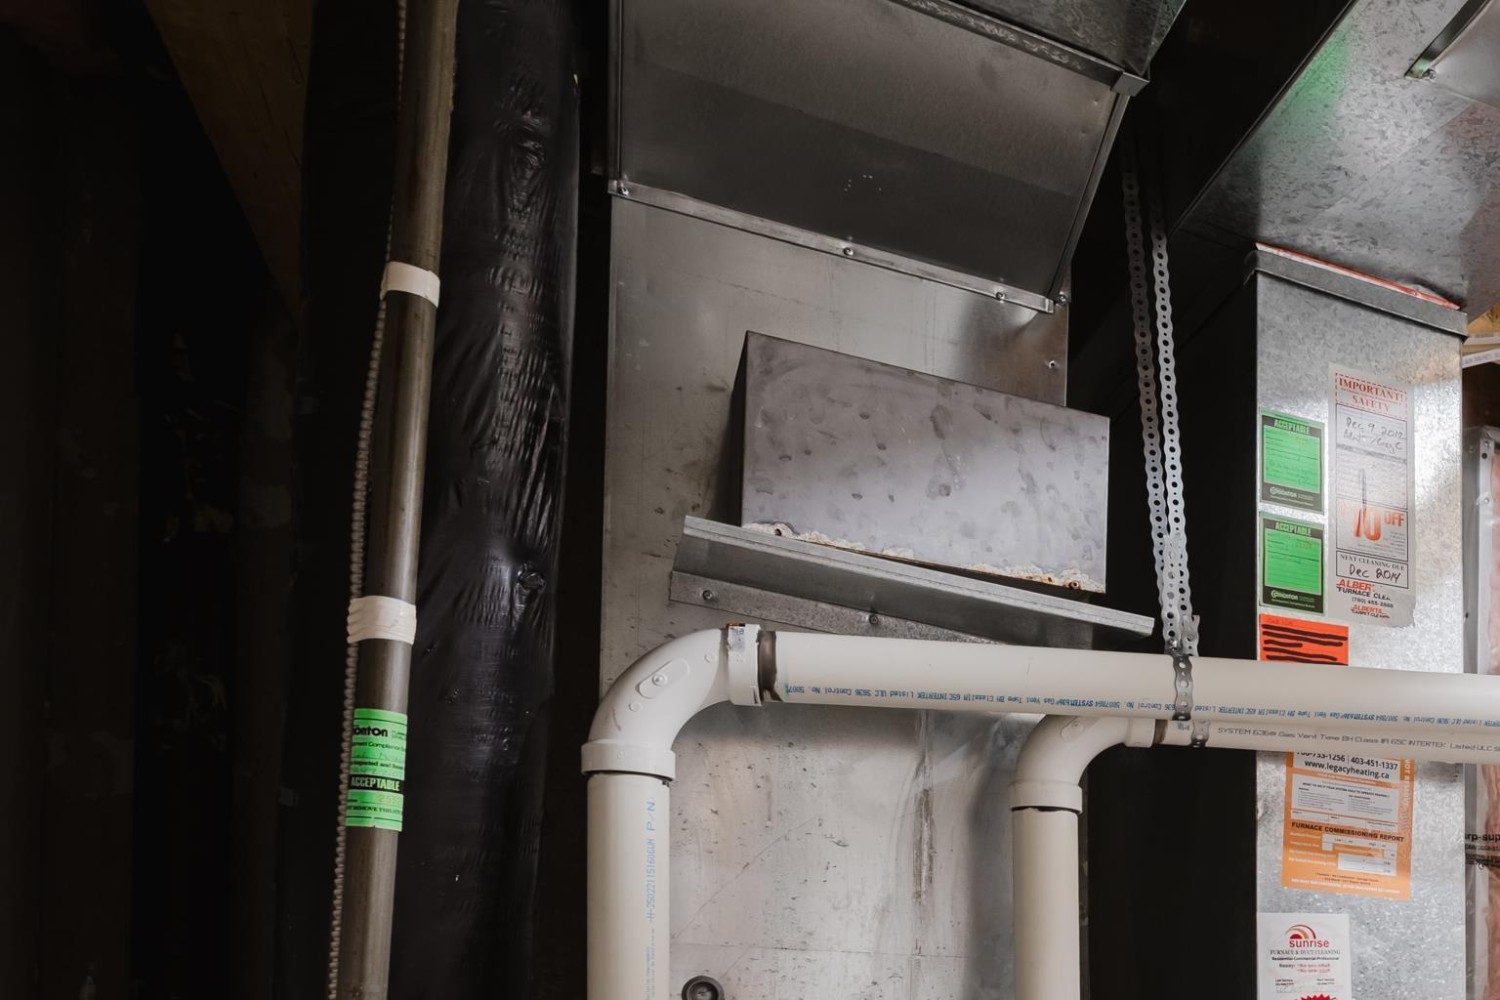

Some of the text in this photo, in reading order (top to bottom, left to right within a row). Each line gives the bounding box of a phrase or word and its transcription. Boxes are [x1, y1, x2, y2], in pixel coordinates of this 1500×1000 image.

[1352, 395, 1391, 412] SAFETY
[1274, 418, 1311, 435] ACCEPTABLE
[1385, 511, 1404, 526] OFF
[1275, 521, 1312, 537] ACCEPTABLE
[1349, 563, 1401, 583] Dec 2014
[1336, 586, 1370, 597] FURNACE
[1218, 727, 1251, 736] SYSTEM
[1278, 730, 1296, 738] Gas
[1298, 732, 1317, 740] Vent
[1408, 740, 1447, 748] INTERTEK
[1304, 760, 1390, 779] www.legacyheating.ca
[1351, 756, 1398, 770] 403-451-1337
[350, 776, 400, 791] ACCEPTABLE
[1292, 822, 1404, 842] FURNACE COMMISSIONING REPORT
[1289, 939, 1330, 948] sunrise
